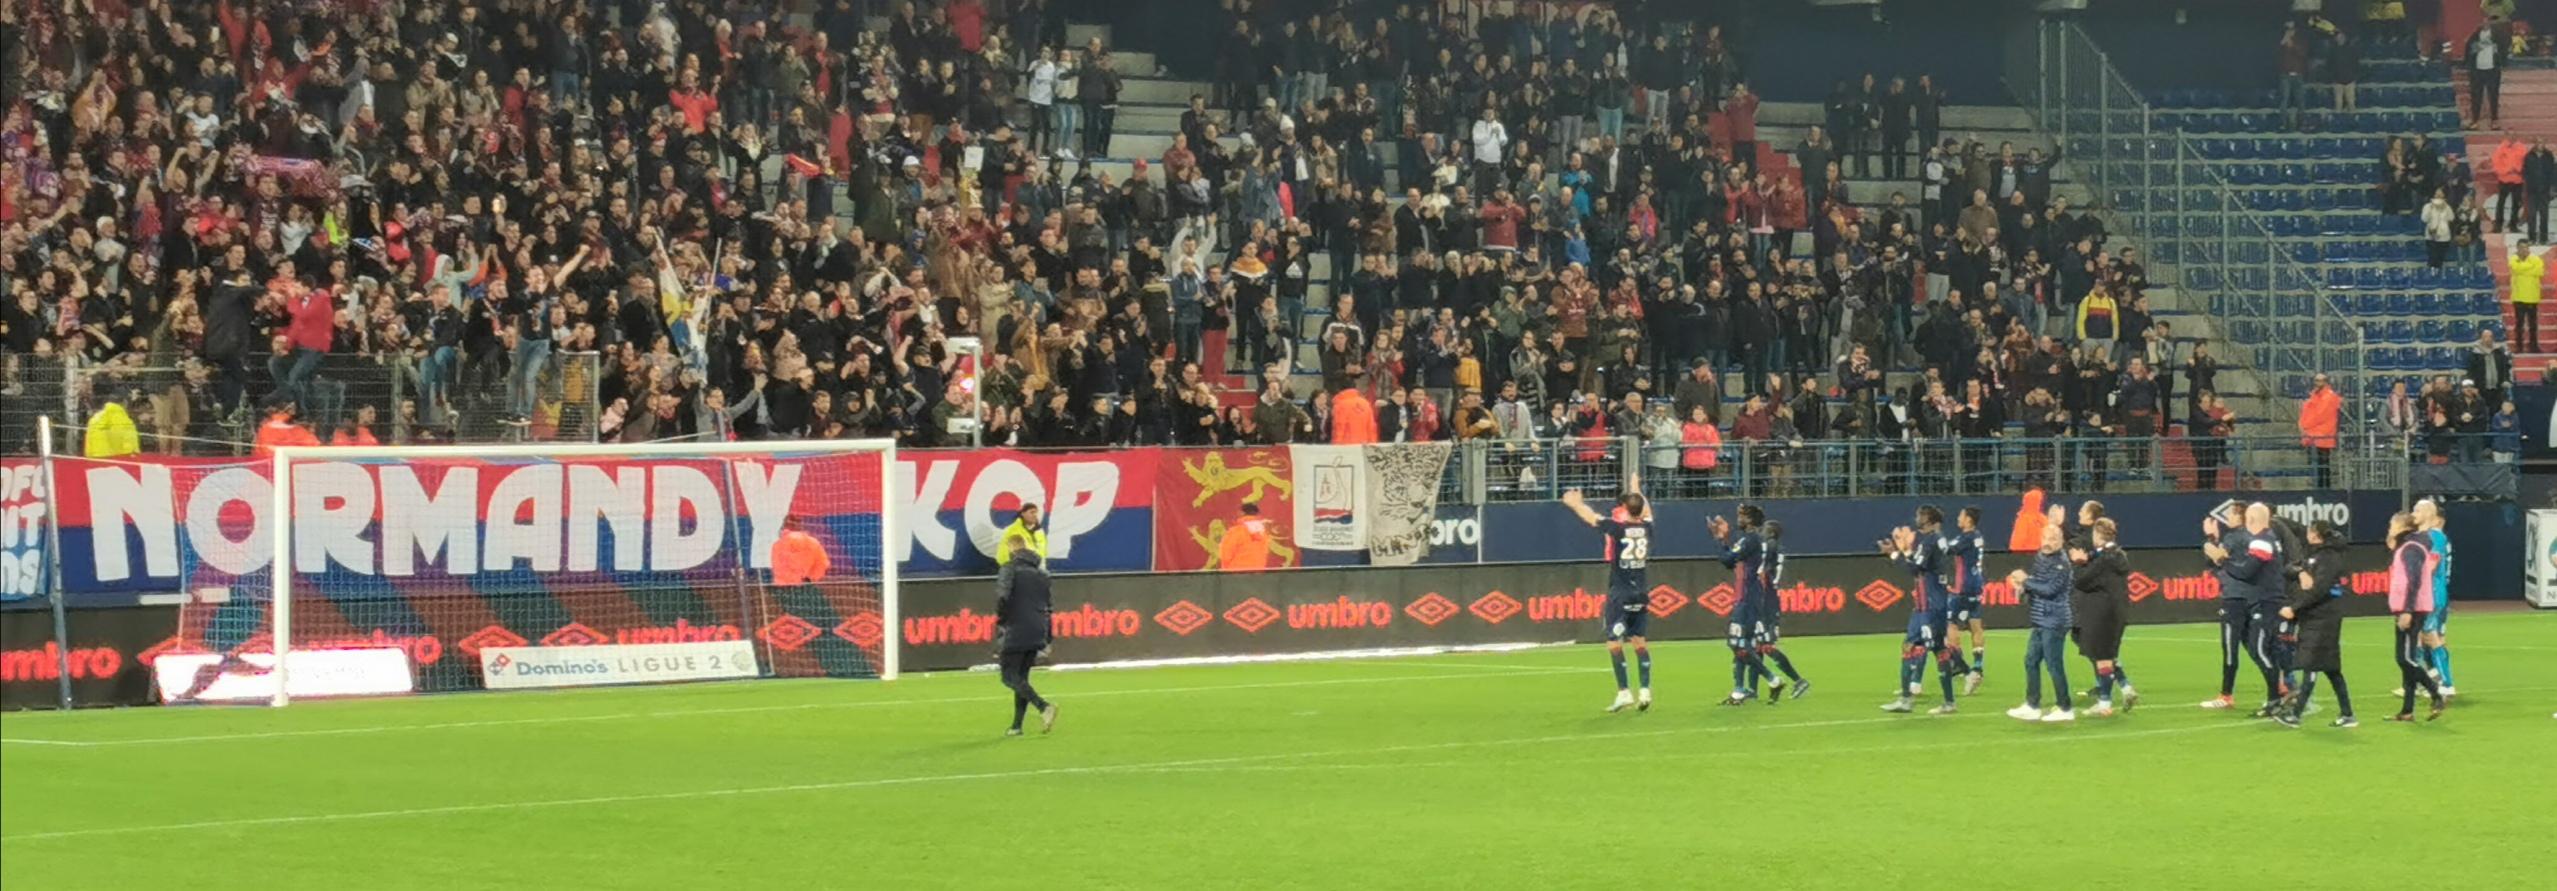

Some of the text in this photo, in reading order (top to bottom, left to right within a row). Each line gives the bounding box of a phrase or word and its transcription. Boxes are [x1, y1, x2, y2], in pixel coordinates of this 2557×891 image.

[86, 458, 1120, 582] NORMANDY KOP
[1620, 537, 1648, 560] 28
[1777, 580, 1847, 613] mbro
[2163, 570, 2223, 600] umb
[1051, 602, 1141, 638] mbro
[1287, 595, 1392, 629] umbro
[1528, 587, 1608, 620] umbr
[904, 607, 998, 645] umbr
[516, 655, 722, 676] Domino's LIGUE 2
